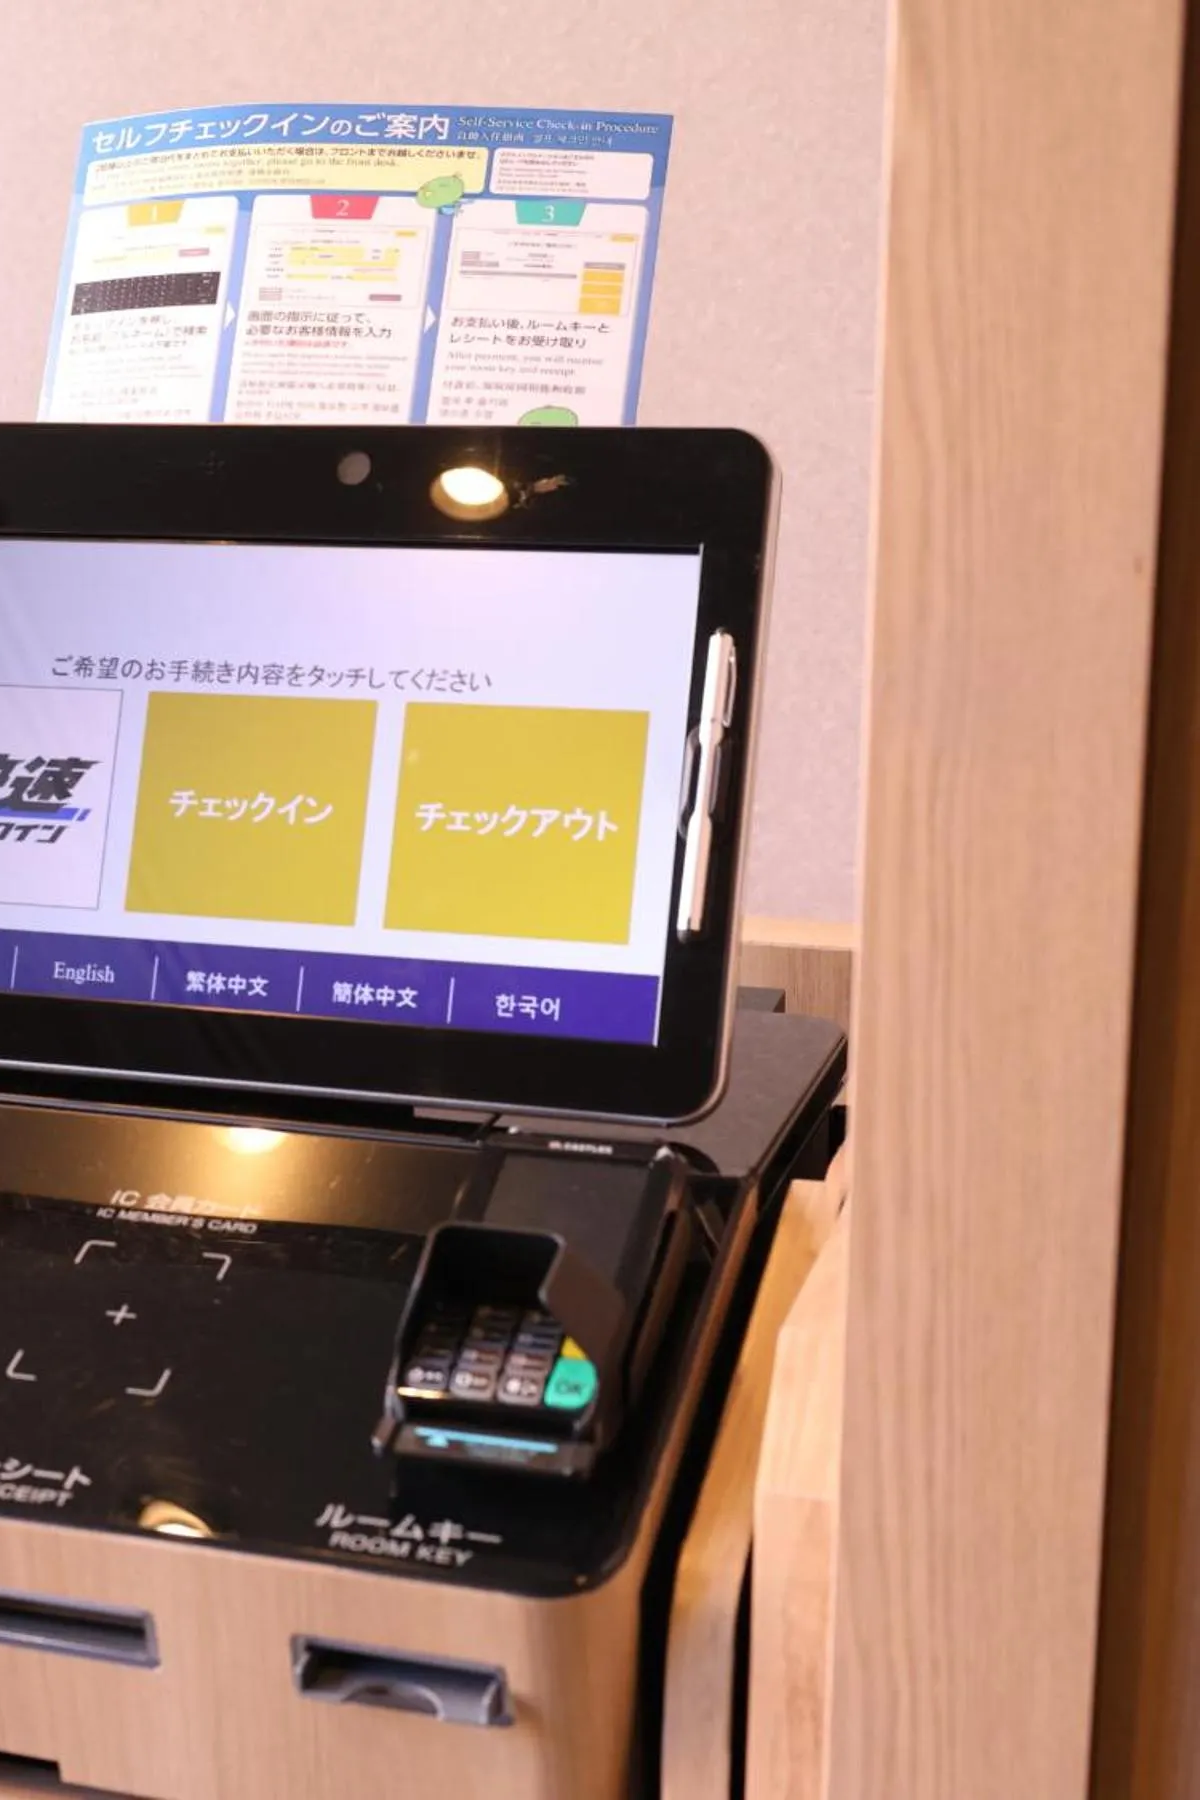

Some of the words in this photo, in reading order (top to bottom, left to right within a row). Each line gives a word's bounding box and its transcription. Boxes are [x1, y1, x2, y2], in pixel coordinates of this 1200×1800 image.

[92, 112, 450, 154] セルフチェックインのご案内
[458, 115, 533, 129] Self-Service
[596, 121, 660, 134] Procedure
[336, 199, 350, 217] 2
[541, 205, 555, 222] 3
[245, 324, 392, 339] 必要なお客様情報を入力
[450, 333, 587, 349] レシートをお受け取り
[51, 655, 493, 694] ご希望のお手続き内容をタッチしてください
[168, 788, 334, 826] チェックイン
[415, 801, 619, 842] チェックアウト
[52, 960, 116, 986] English
[185, 970, 270, 998] 繁体中文
[331, 980, 419, 1009] 簡体中文
[494, 993, 562, 1022] 한국어
[109, 1188, 142, 1208] IC
[95, 1206, 116, 1219] IC
[207, 1219, 259, 1235] CARD
[315, 1502, 504, 1545] ルームキー
[328, 1530, 412, 1559] ROOM
[414, 1542, 475, 1567] KEY
